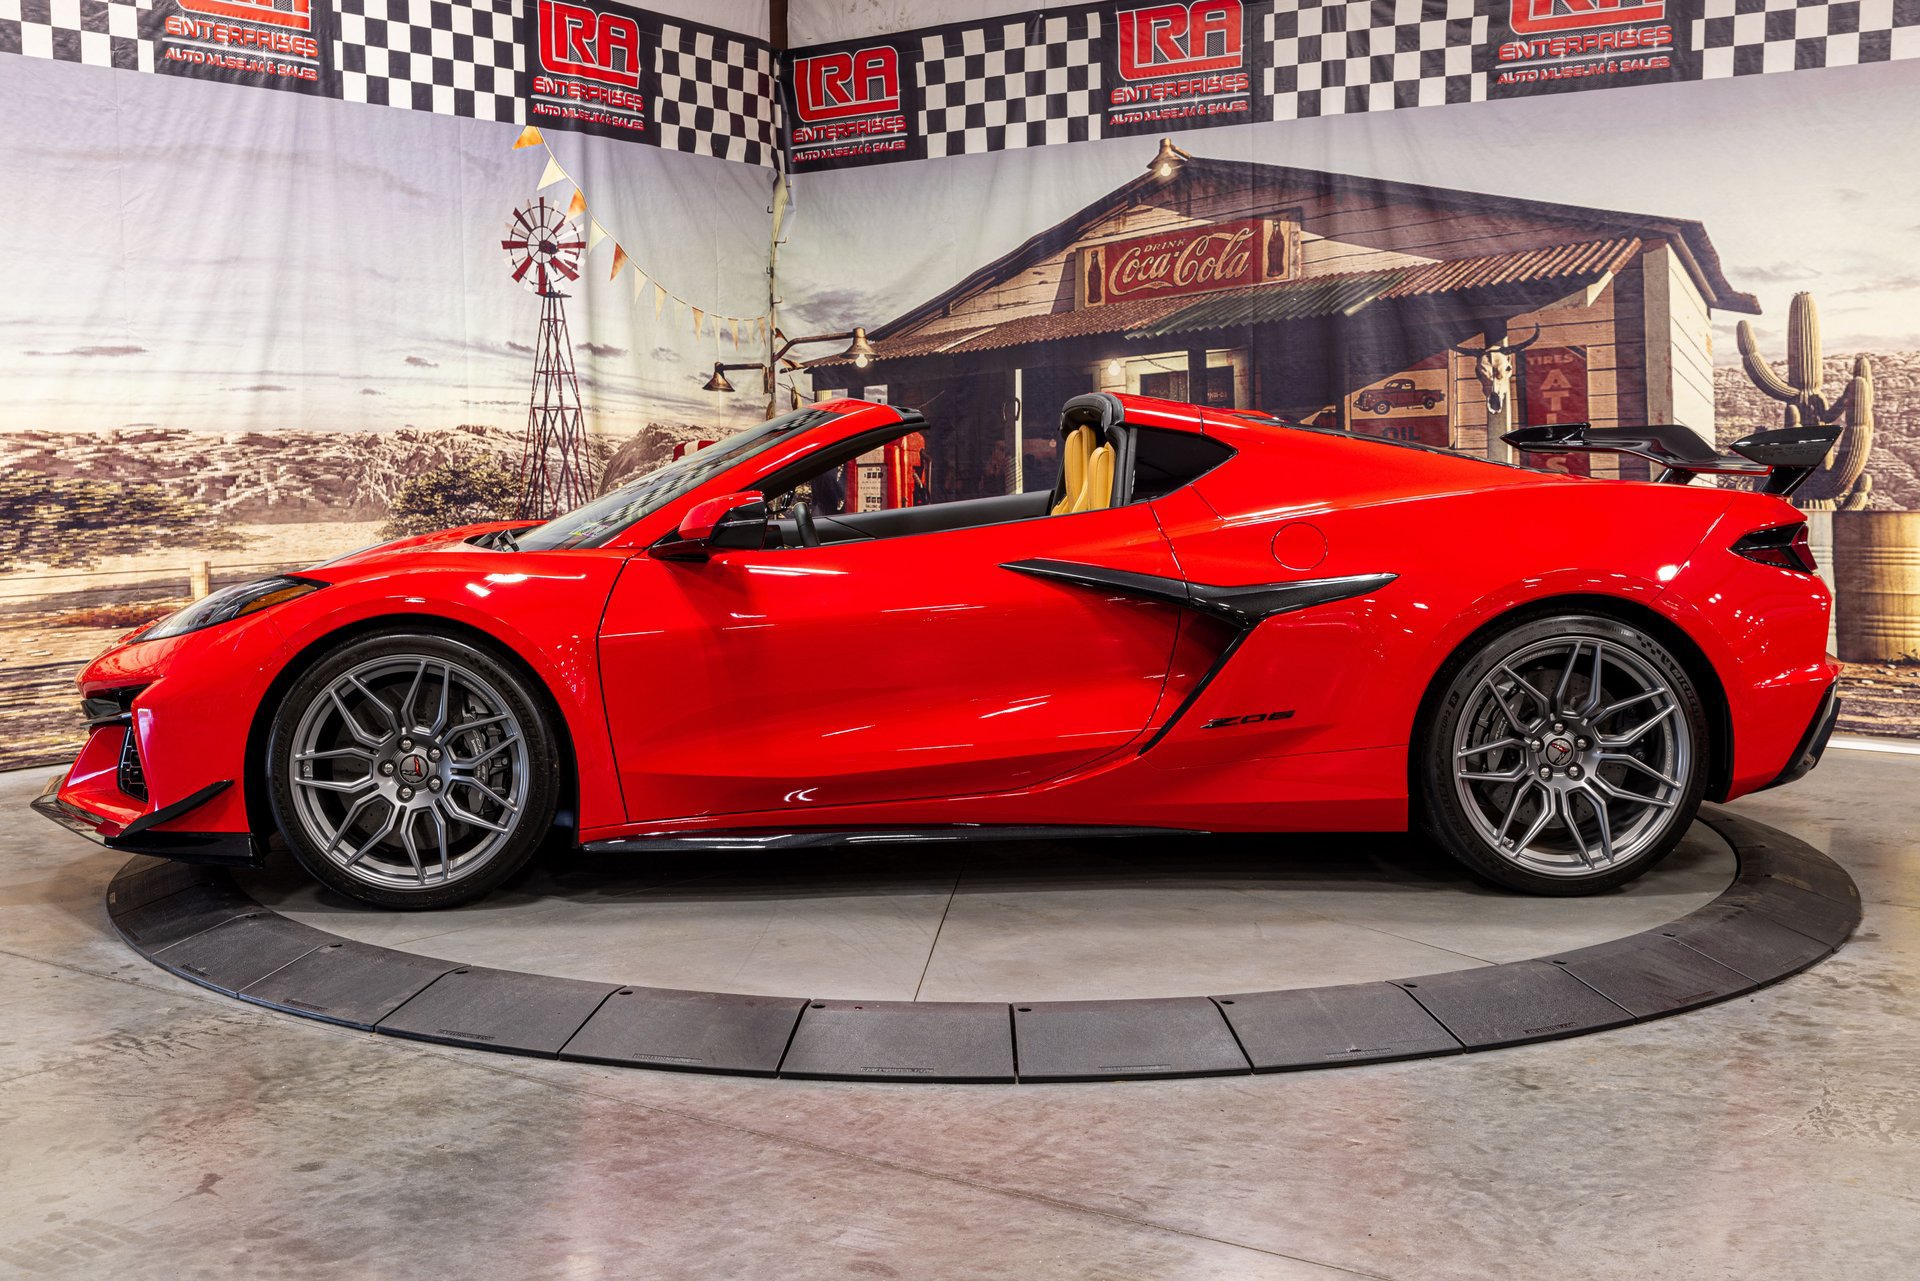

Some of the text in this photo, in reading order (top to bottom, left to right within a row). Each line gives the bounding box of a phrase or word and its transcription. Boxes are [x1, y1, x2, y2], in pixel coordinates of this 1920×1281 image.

[165, 15, 319, 58] ENTERPRISES
[1498, 25, 1673, 61] ENTERPRISES
[164, 47, 319, 82] AUTO MUSEUM & SALES
[1497, 56, 1671, 85] AUTO MUSEUM & SALES
[533, 75, 645, 111] ENTERPRISES
[1110, 73, 1249, 105] ENTERPRISES
[532, 103, 645, 131] AUTO MUSEUM & SALES
[1109, 100, 1249, 126] AUTO MUSEUM & SALES
[792, 115, 907, 144] ENTERPRISES
[792, 140, 907, 163] AUTO MUSEUM & SALES
[1143, 238, 1187, 253] DRINK
[1108, 227, 1258, 296] Coca-Cola
[1527, 354, 1574, 366] TIRES
[1382, 425, 1422, 441] OIL
